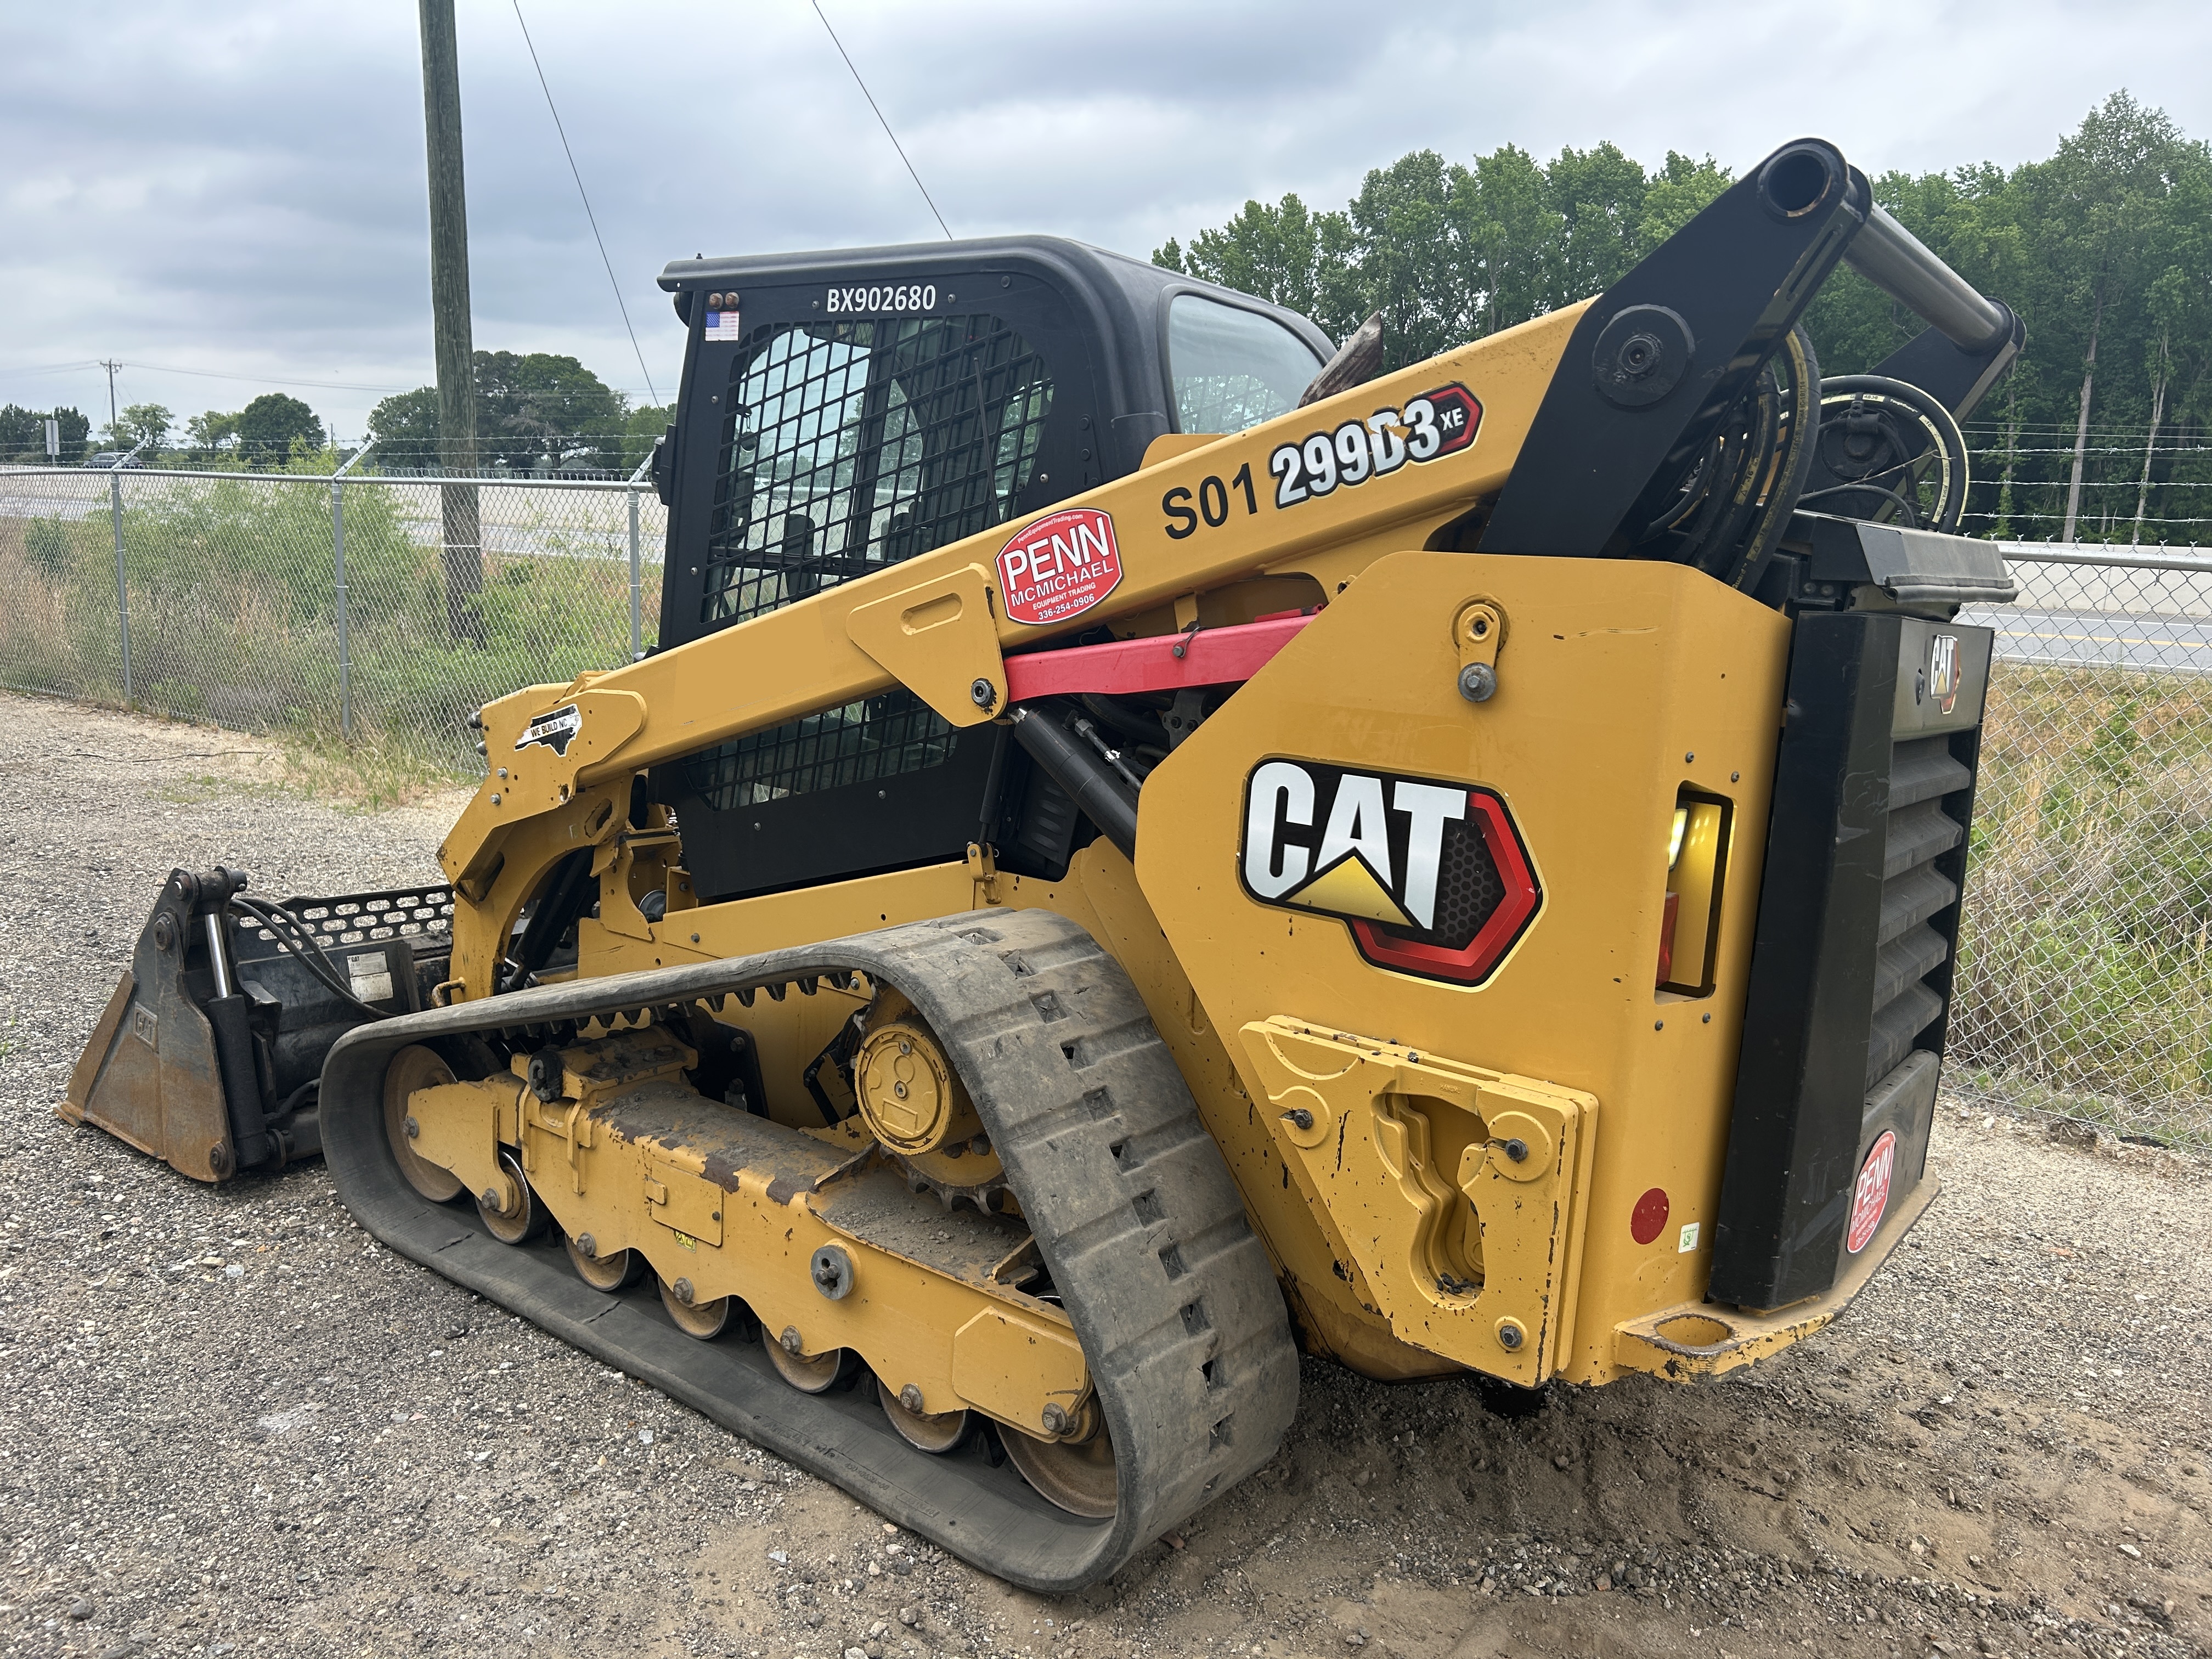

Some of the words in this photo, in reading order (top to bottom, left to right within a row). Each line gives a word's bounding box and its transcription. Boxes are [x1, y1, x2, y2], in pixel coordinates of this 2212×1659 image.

[827, 284, 936, 312] BX902680
[1272, 399, 1441, 505] 299D3
[1440, 408, 1464, 432] XE
[1161, 462, 1258, 540] S01
[1017, 514, 1084, 544] PennEquipmentTrading.com
[1003, 516, 1110, 591] PENN
[1011, 560, 1114, 607] MCMICHAEL
[1032, 594, 1068, 610] EQUIPMENT
[1068, 582, 1096, 597] TRADING
[1038, 593, 1095, 620] 336-254-0906
[1931, 637, 1954, 697] CAT
[531, 727, 541, 737] WE
[541, 721, 558, 735] BUILD
[558, 719, 568, 728] NC
[1245, 762, 1467, 930] CAT
[136, 1012, 155, 1043] CAT
[1854, 1141, 1893, 1216] PENN
